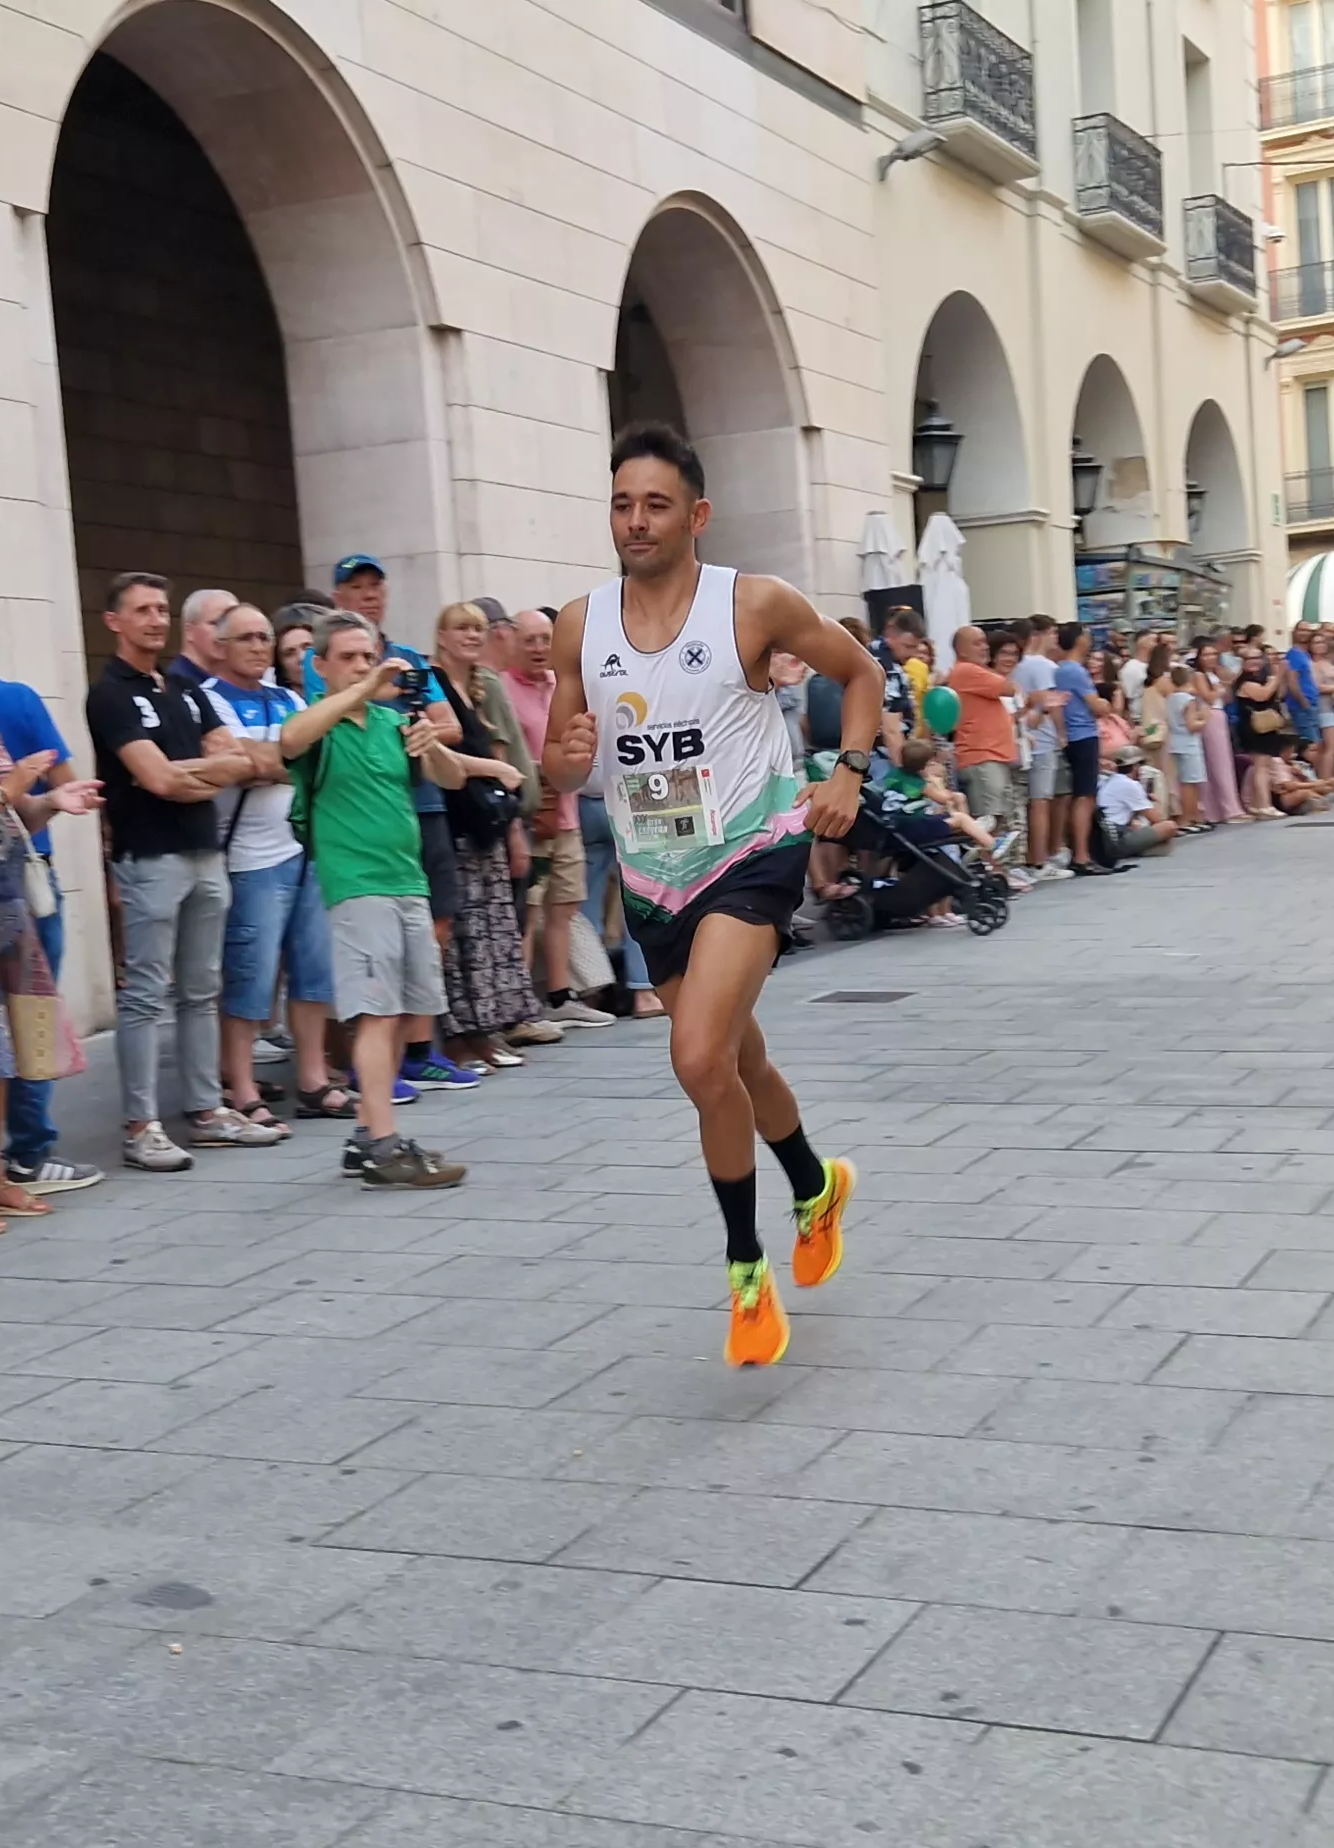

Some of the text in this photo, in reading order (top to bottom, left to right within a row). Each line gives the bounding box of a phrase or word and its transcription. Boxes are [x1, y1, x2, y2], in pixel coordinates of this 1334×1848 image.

[132, 695, 161, 728] 3
[616, 728, 705, 766] SYB
[648, 774, 669, 800] 9
